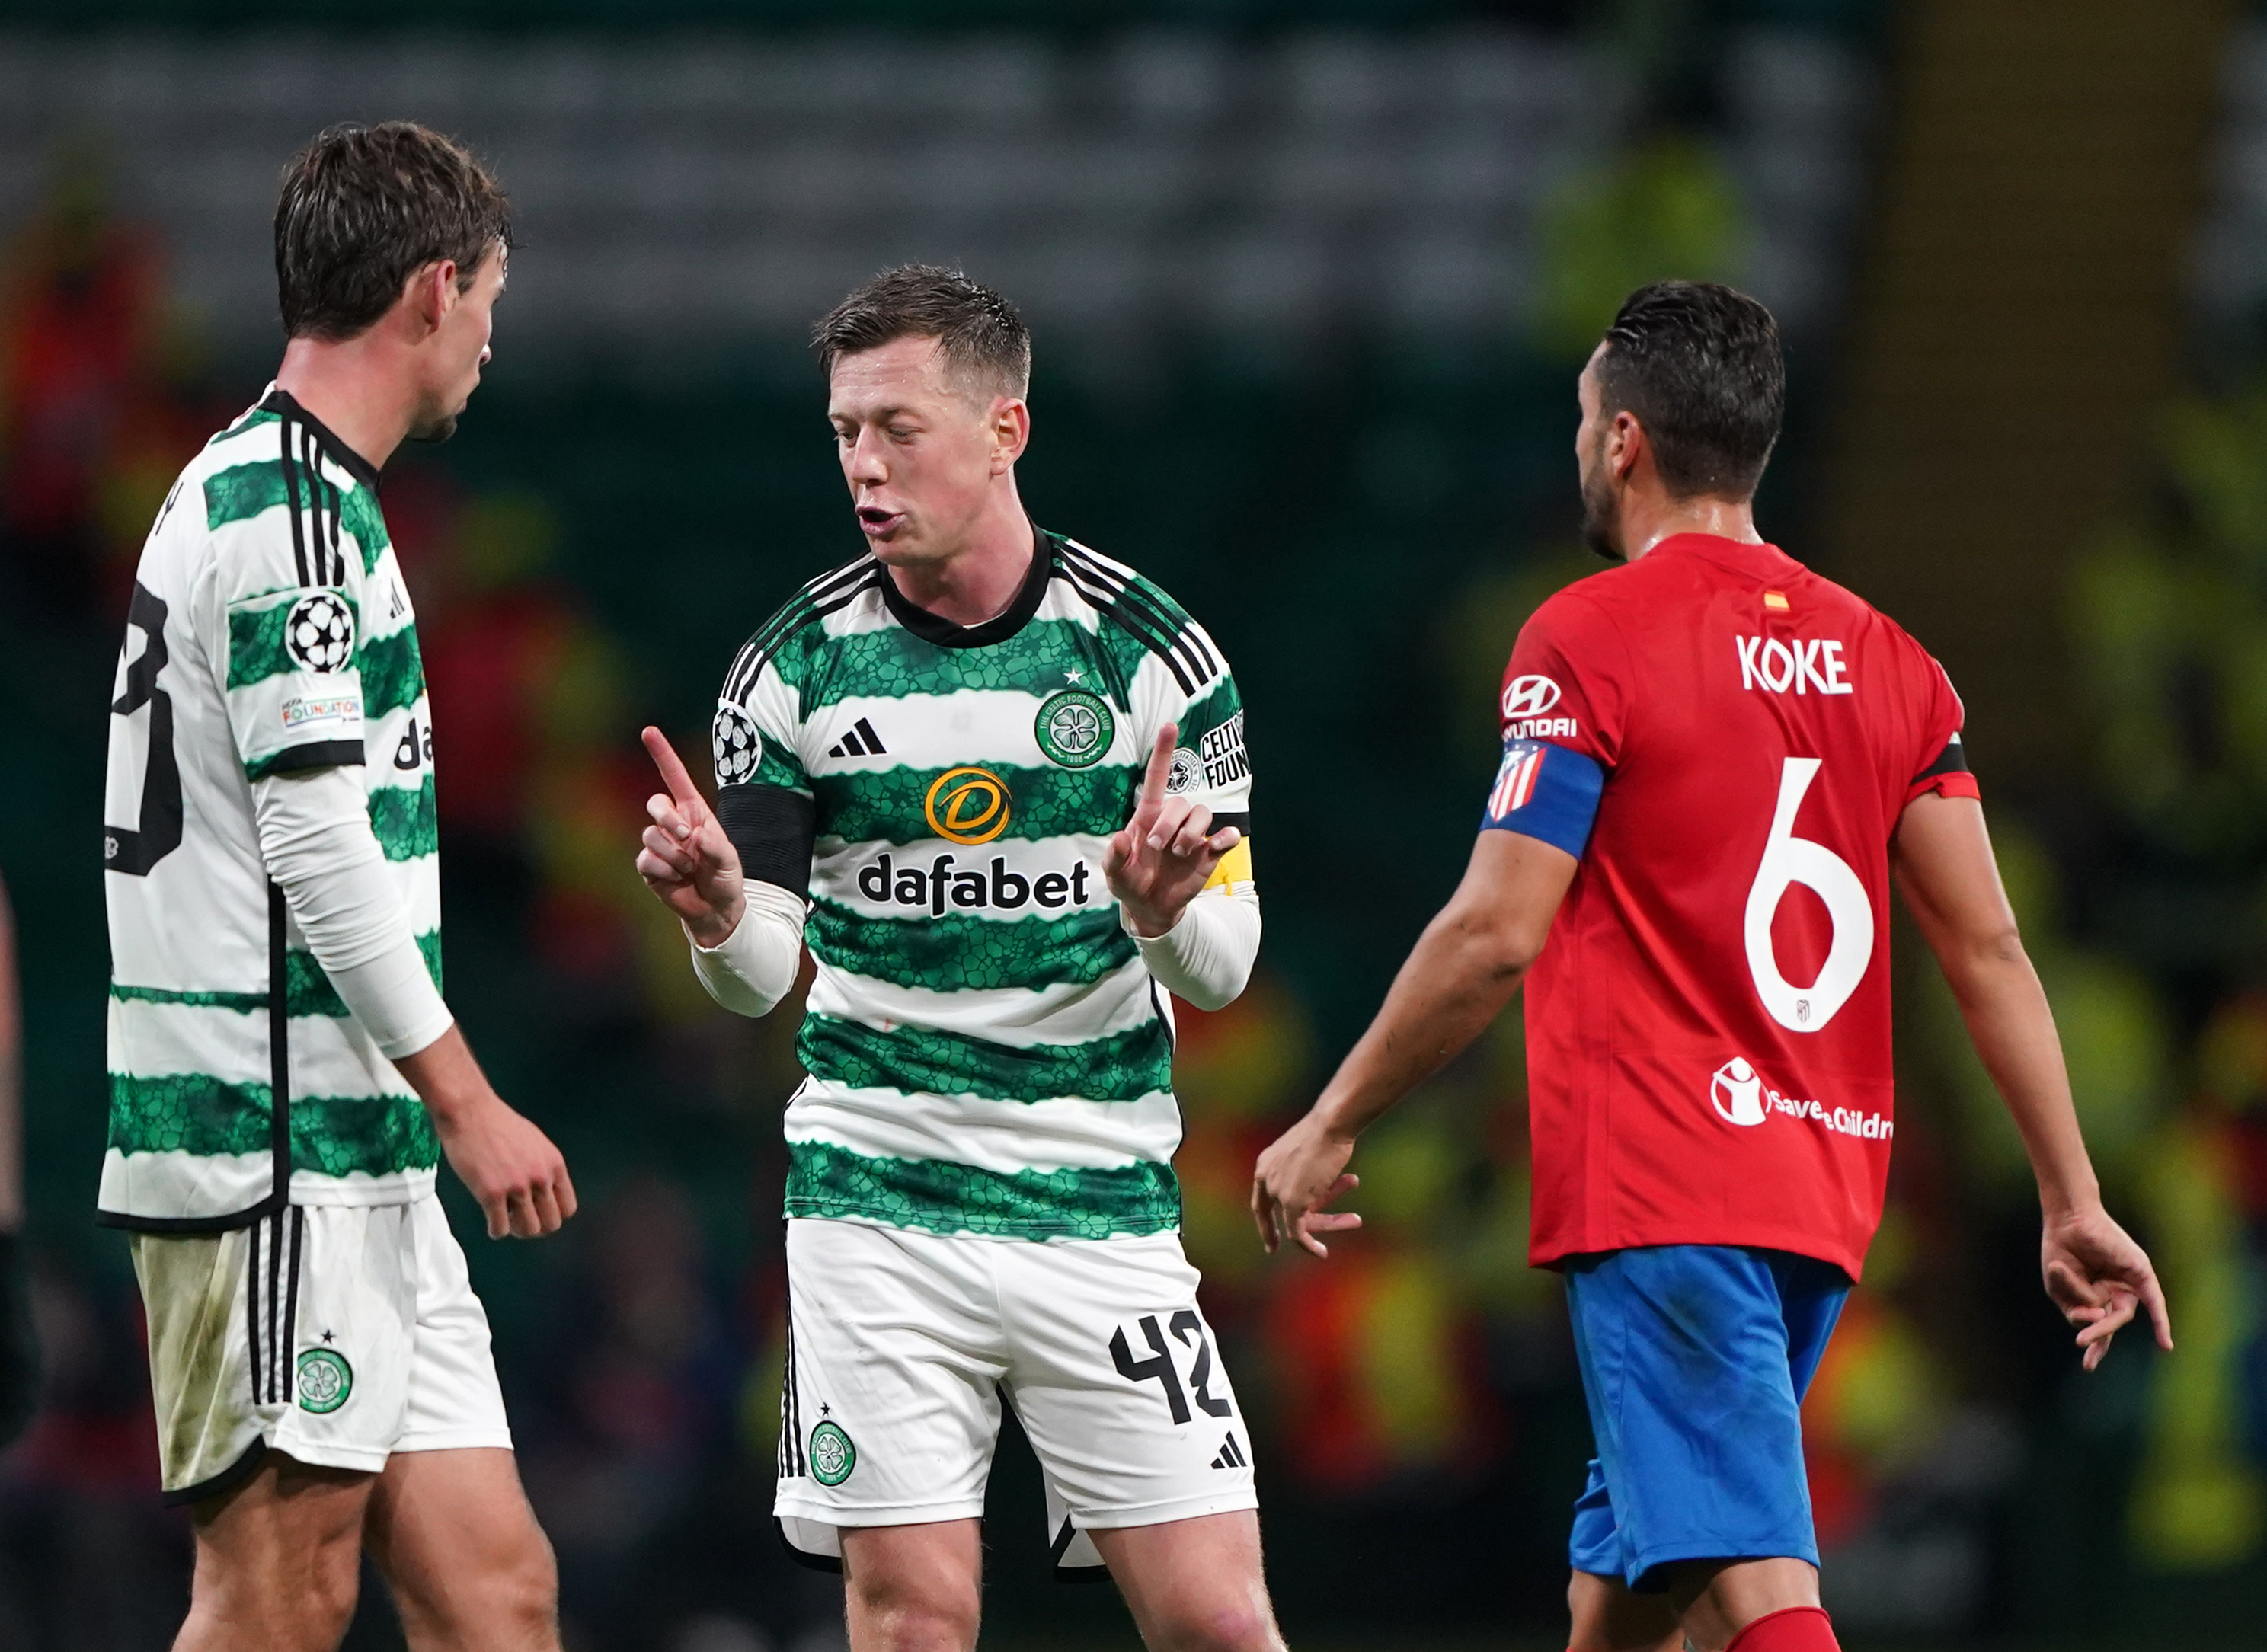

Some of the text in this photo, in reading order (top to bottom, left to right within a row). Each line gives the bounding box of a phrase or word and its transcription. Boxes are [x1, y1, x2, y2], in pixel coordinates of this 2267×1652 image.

[1735, 634, 1853, 695] KOKE
[1039, 695, 1111, 731] THE CELTIC FOOTBALL CLUB
[1201, 717, 1243, 763] CELTI
[857, 853, 1089, 917] dafabet
[1744, 756, 1875, 1033] 6
[1770, 1090, 1824, 1120] Save
[1108, 1309, 1233, 1426] 42
